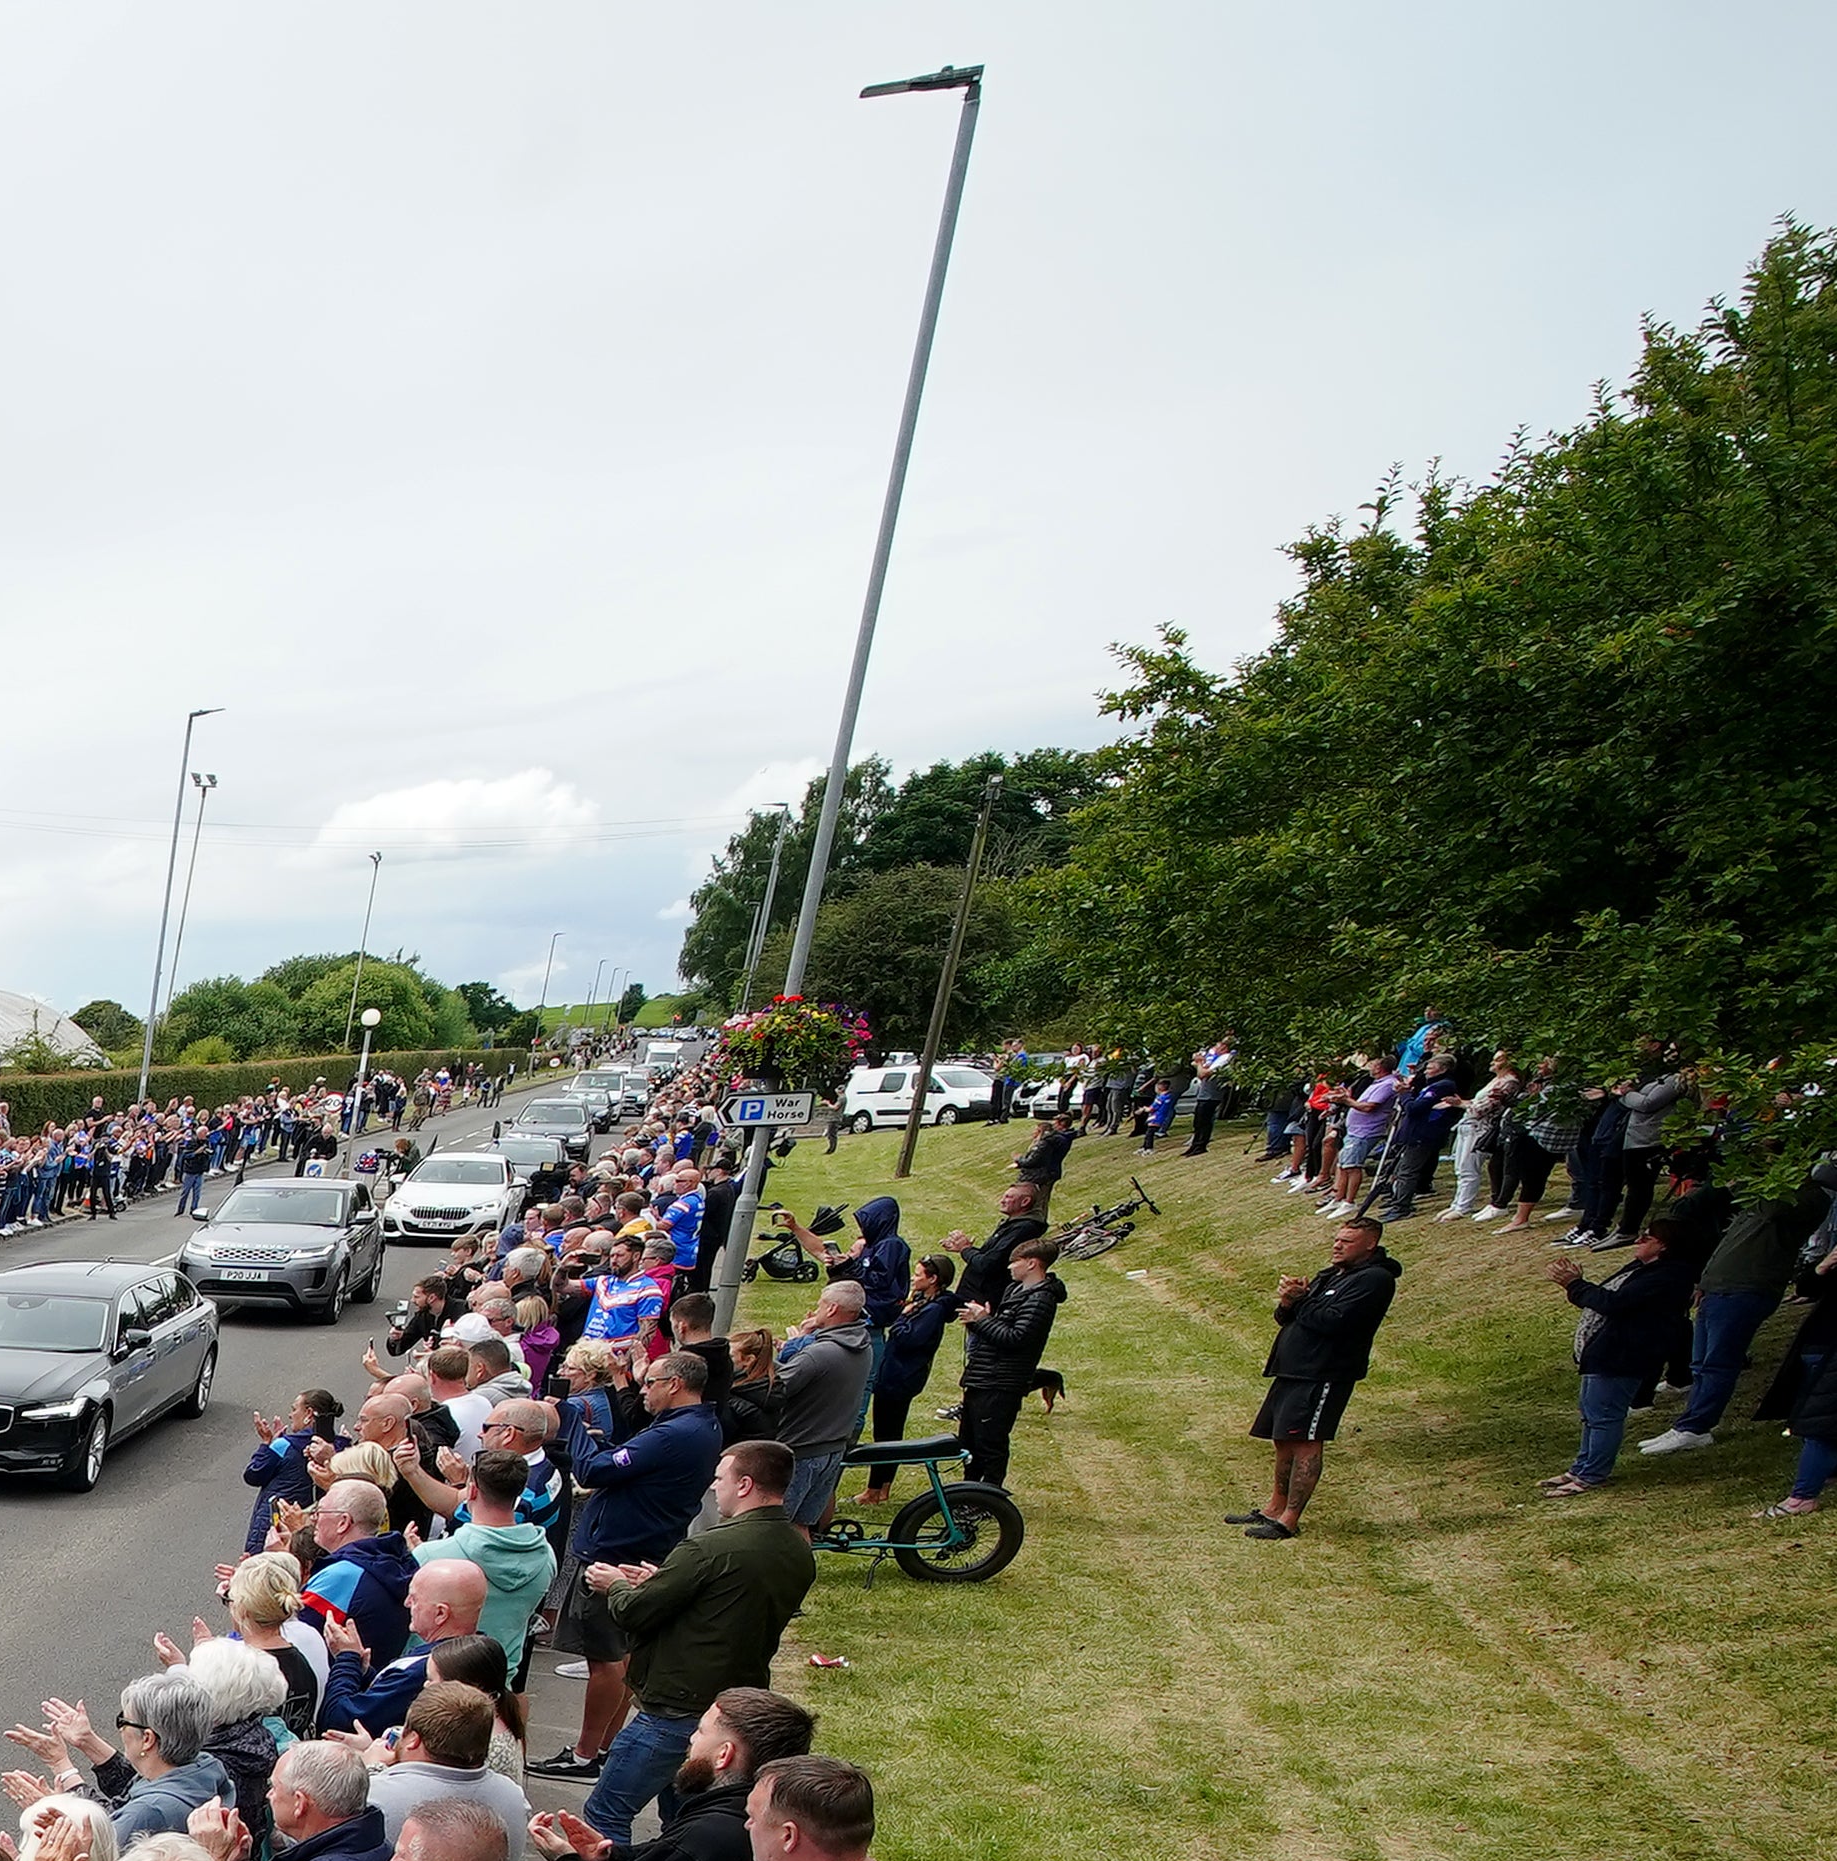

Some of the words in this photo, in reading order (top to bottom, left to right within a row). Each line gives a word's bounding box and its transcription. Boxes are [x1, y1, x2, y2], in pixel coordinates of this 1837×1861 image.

[774, 1098, 800, 1108] War
[767, 1110, 805, 1120] Horse
[227, 1271, 243, 1279] P20
[245, 1272, 261, 1280] JJA
